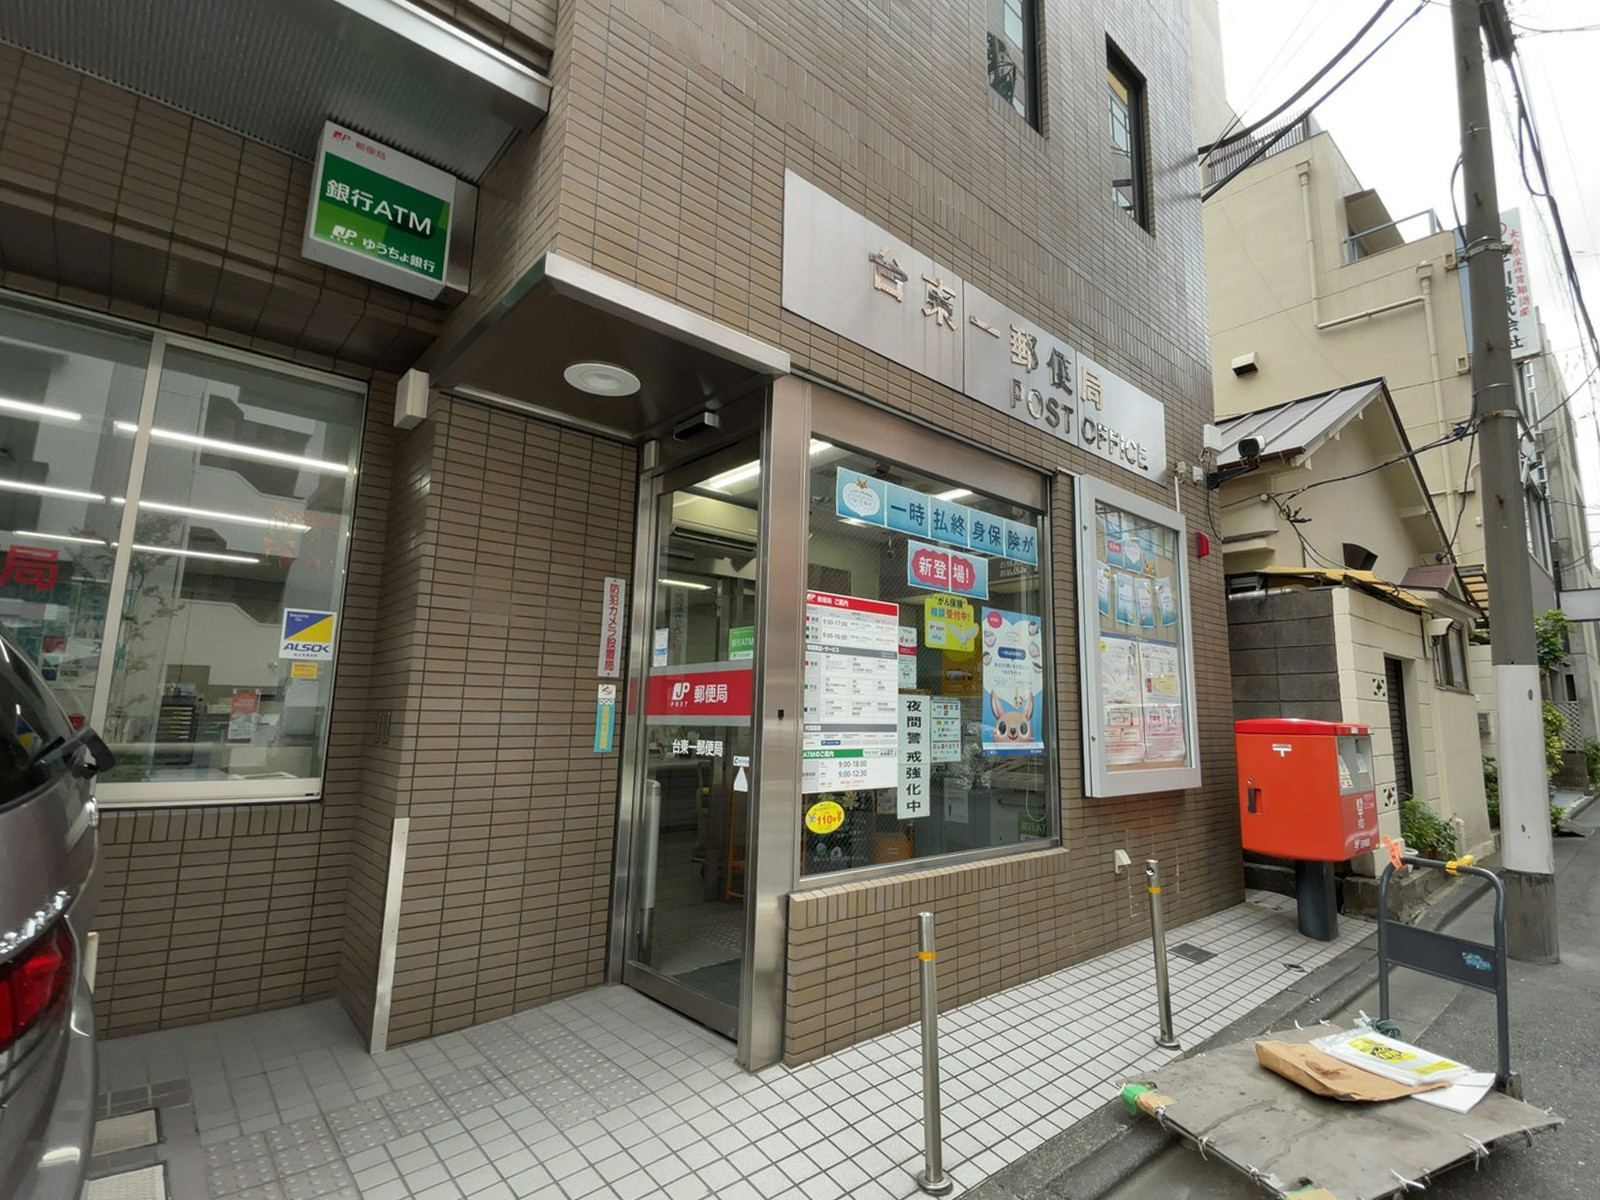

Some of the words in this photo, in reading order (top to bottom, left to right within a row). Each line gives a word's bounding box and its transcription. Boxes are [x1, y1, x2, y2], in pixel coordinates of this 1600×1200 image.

[325, 179, 432, 236] 銀行ATM
[362, 238, 436, 273] ゆうちょ銀行
[868, 246, 1103, 412] 台東一郵便局
[1010, 377, 1074, 434] POST
[1080, 423, 1150, 472] OFFICE
[890, 502, 1034, 555] 一時払終身保険が
[0, 544, 59, 591] 局
[918, 554, 971, 585] 新登場!
[283, 642, 331, 654] ALSOK
[694, 684, 728, 703] 郵便局
[672, 738, 724, 757] 台東一郵便局
[906, 700, 922, 812] 夜間警戒強化中
